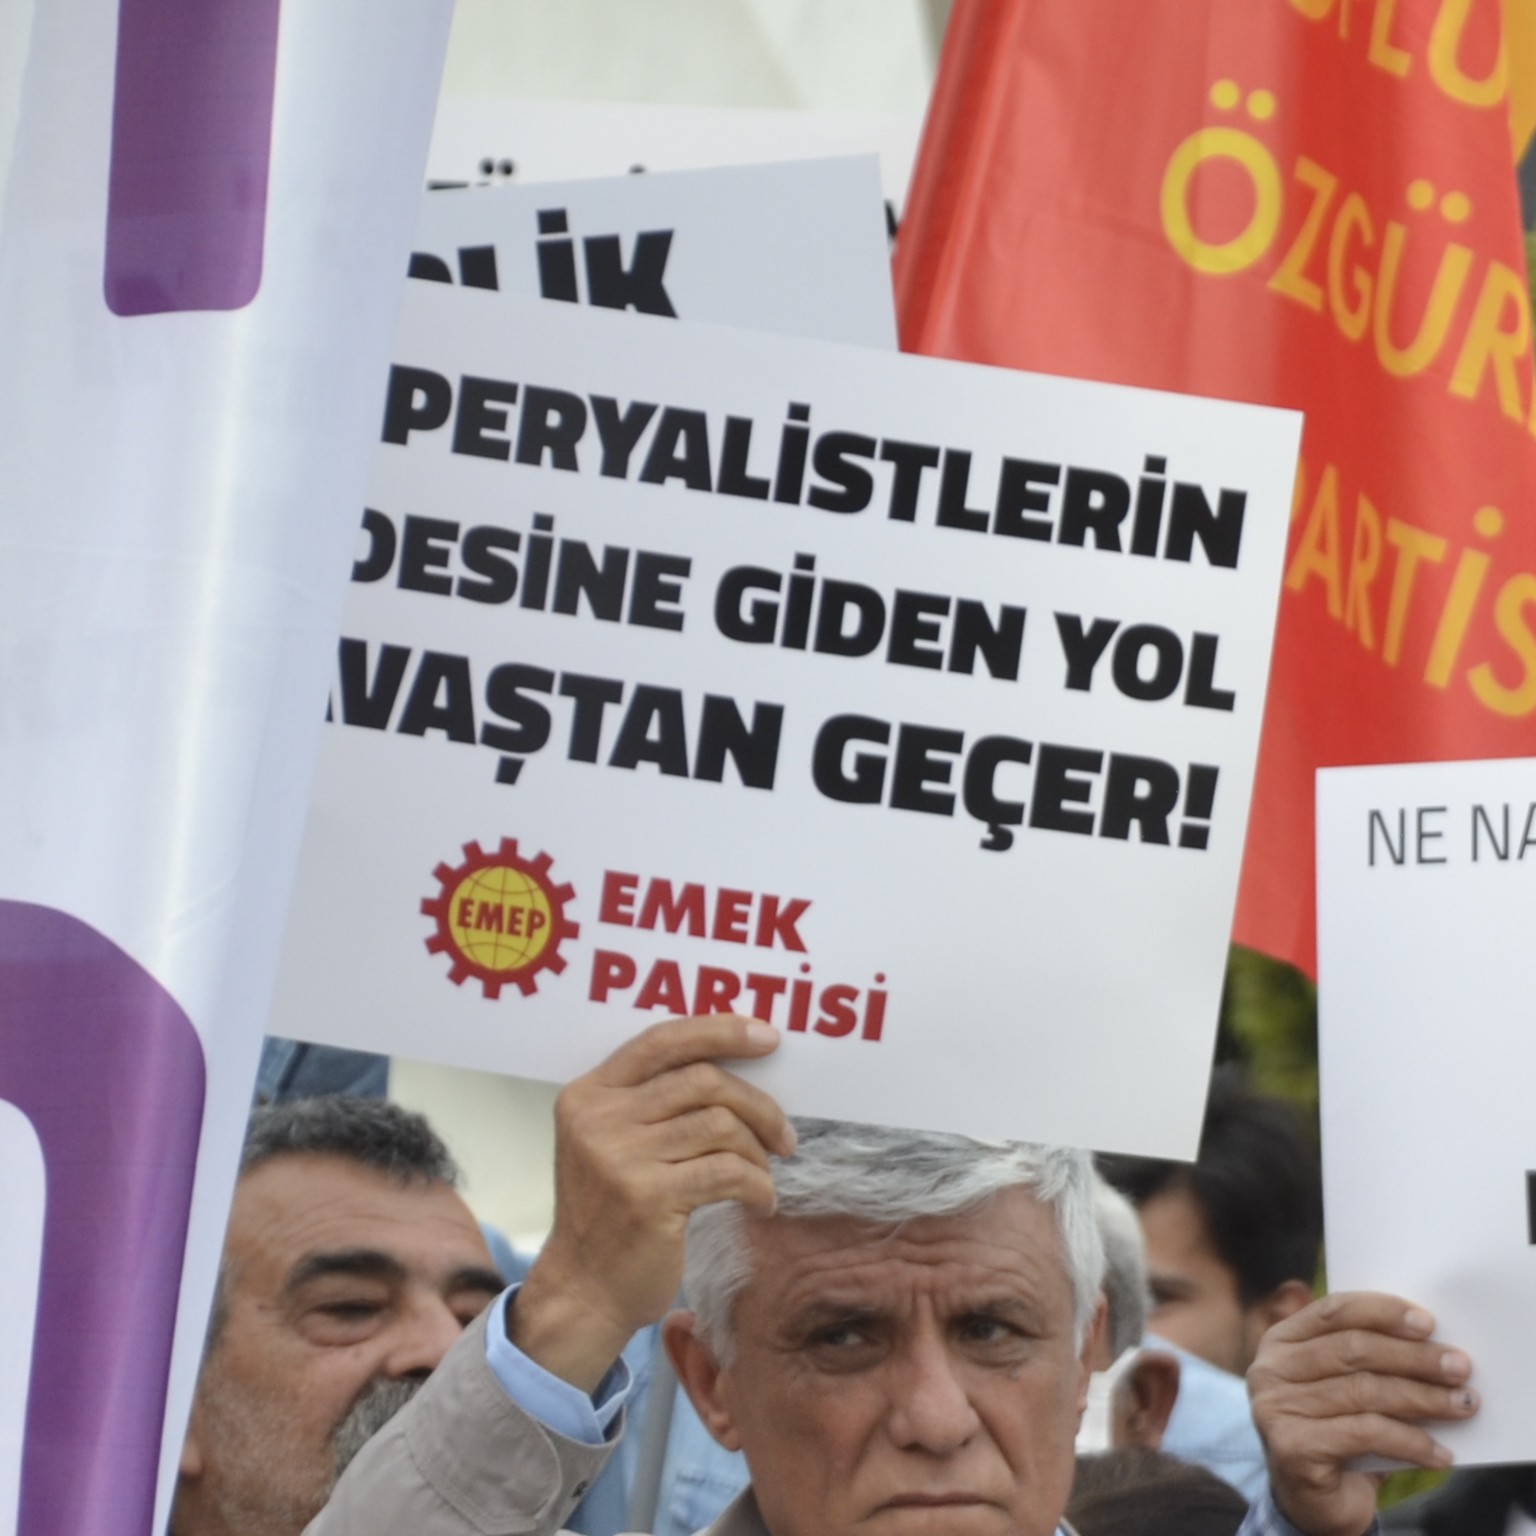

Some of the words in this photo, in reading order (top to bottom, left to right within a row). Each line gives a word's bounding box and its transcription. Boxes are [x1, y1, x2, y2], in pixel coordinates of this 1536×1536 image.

[380, 364, 1247, 570] PERYALİSTLERİN
[714, 552, 1027, 682] GİDEN
[1054, 612, 1236, 712] YOL
[325, 636, 785, 791] VAŞTAN
[811, 713, 1220, 853] GEÇER!
[1368, 806, 1448, 867] NE
[457, 897, 546, 940] EMEP
[598, 870, 812, 954] EMEK
[588, 949, 888, 1042] PARTİSİ
